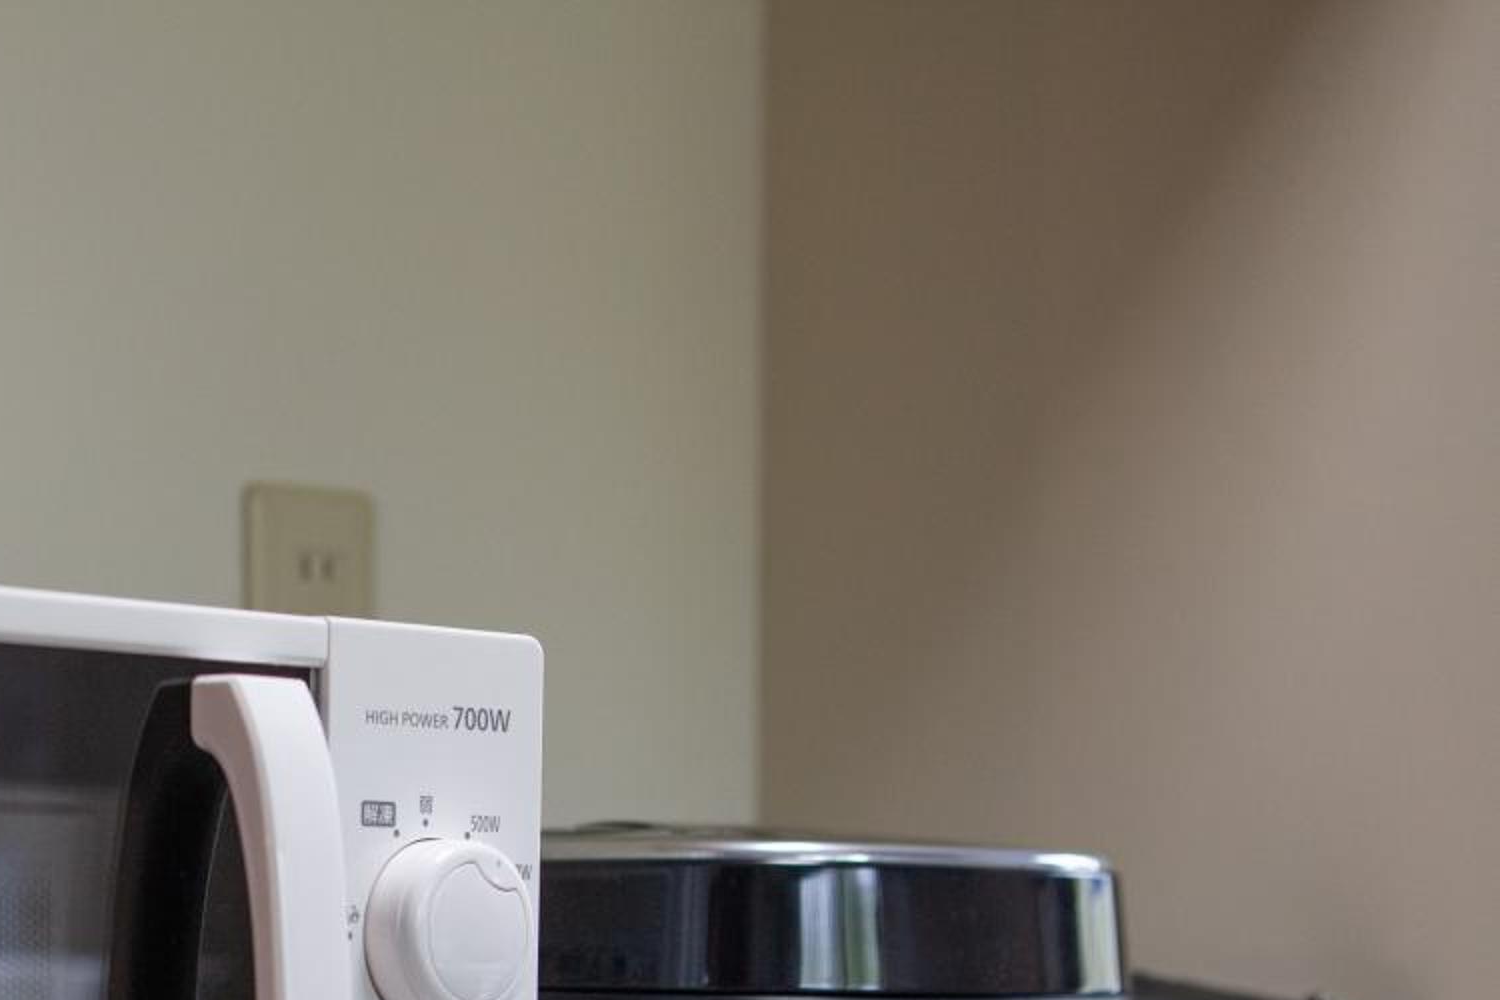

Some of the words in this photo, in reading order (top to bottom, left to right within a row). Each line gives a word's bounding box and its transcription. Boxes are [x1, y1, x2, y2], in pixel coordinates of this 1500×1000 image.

[365, 710, 399, 727] HIGH
[402, 711, 449, 729] POWER
[453, 707, 511, 733] 700W
[470, 815, 501, 833] 500W
